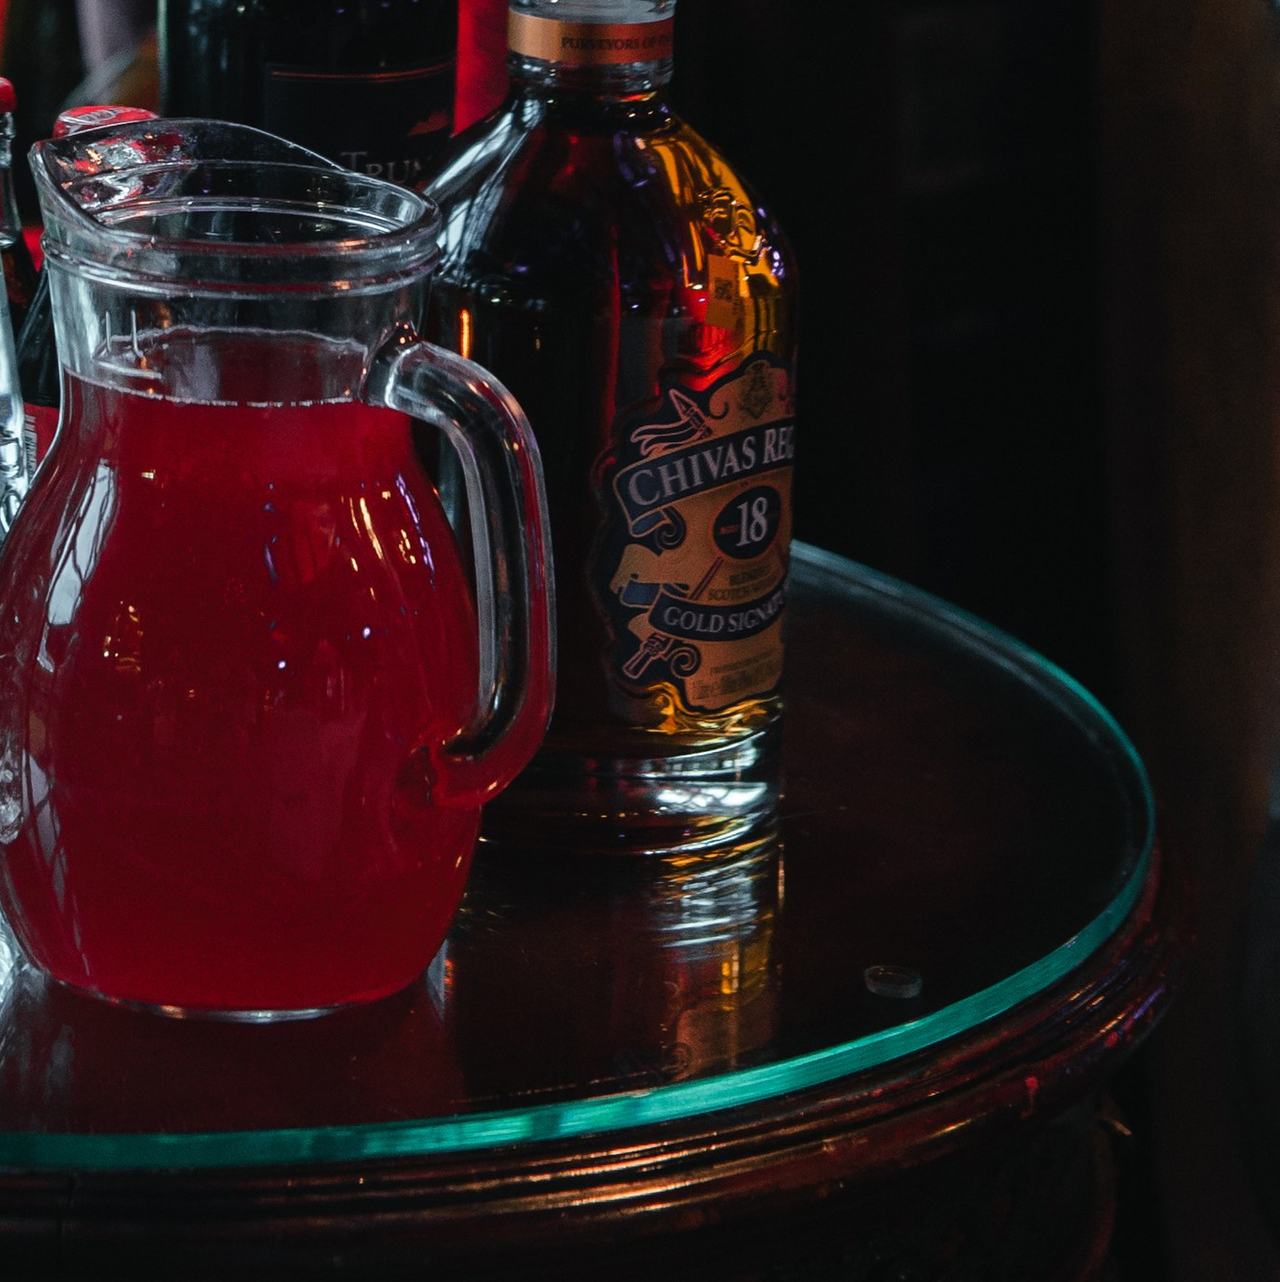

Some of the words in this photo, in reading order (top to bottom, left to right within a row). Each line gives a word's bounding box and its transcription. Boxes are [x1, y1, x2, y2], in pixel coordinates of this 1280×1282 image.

[339, 151, 432, 185] TRU
[628, 436, 756, 506] CHIVAS
[736, 497, 768, 547] 18
[664, 607, 724, 633] GOLD
